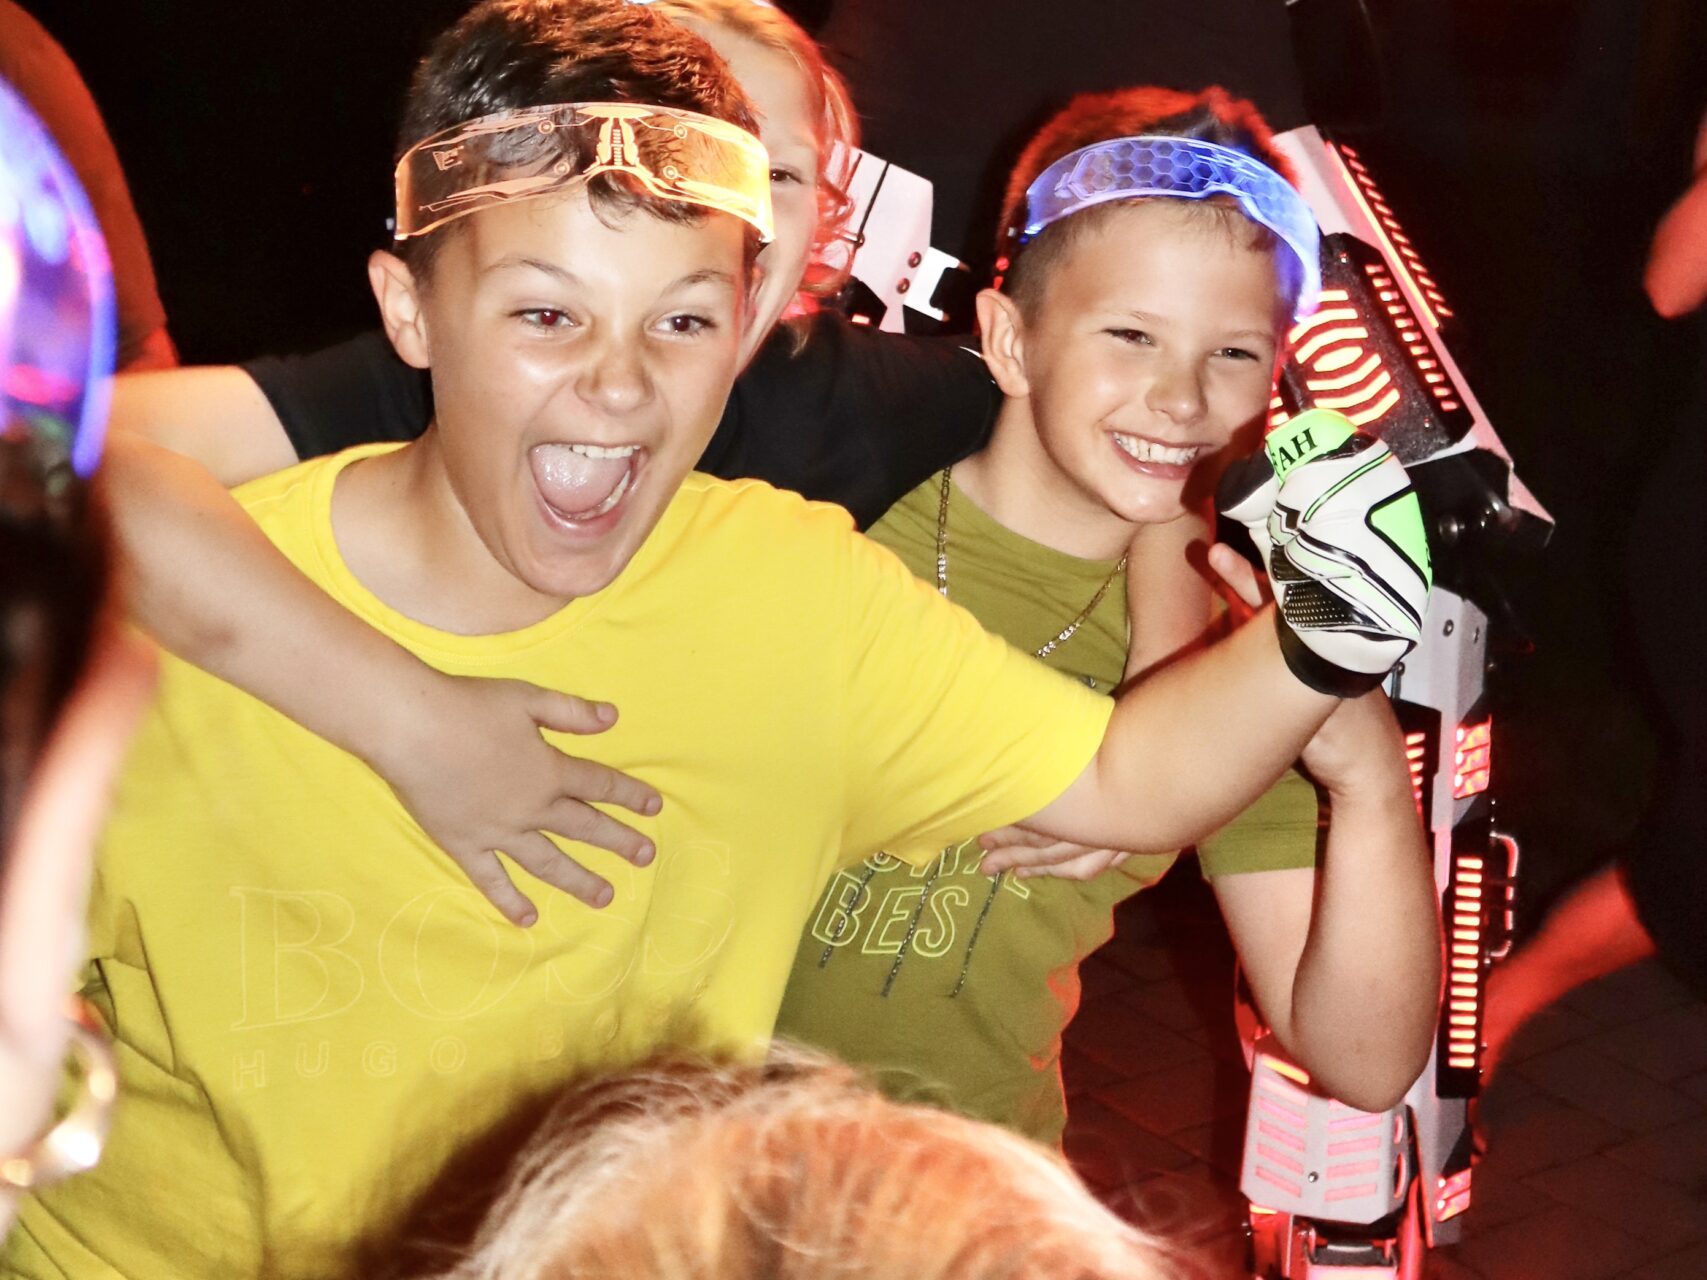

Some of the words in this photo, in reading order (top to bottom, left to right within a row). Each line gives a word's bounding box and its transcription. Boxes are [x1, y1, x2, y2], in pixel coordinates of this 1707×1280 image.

[1271, 427, 1318, 471] AH
[229, 841, 735, 1032] BOSS
[231, 1036, 467, 1091] HUGO
